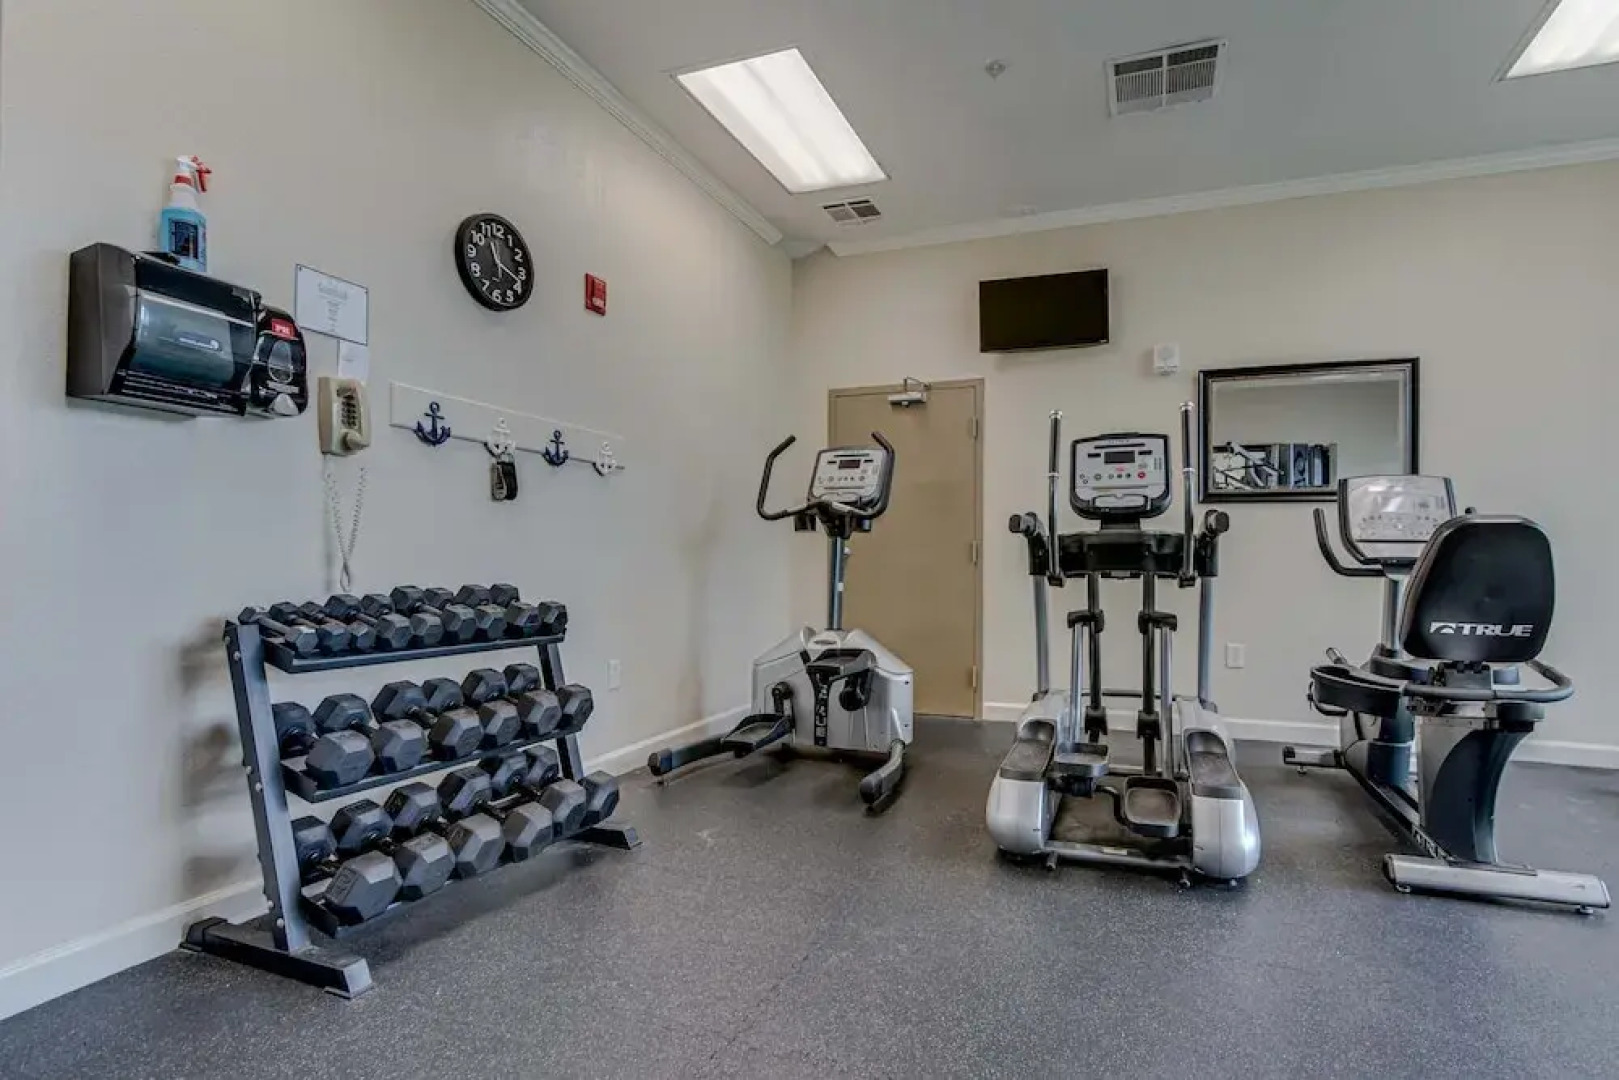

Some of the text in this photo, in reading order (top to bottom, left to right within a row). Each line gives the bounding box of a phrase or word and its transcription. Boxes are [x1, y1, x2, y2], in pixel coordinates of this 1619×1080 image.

[480, 222, 491, 238] 11
[491, 222, 505, 239] 12
[471, 230, 485, 246] 10
[507, 234, 513, 247] 1
[467, 244, 476, 258] 9
[514, 248, 523, 262] 2
[470, 262, 481, 277] 8
[518, 266, 526, 281] 3
[482, 279, 490, 291] 7
[513, 280, 521, 294] 4
[492, 289, 502, 302] 6
[505, 289, 514, 302] 5
[1458, 622, 1534, 637] TRUE
